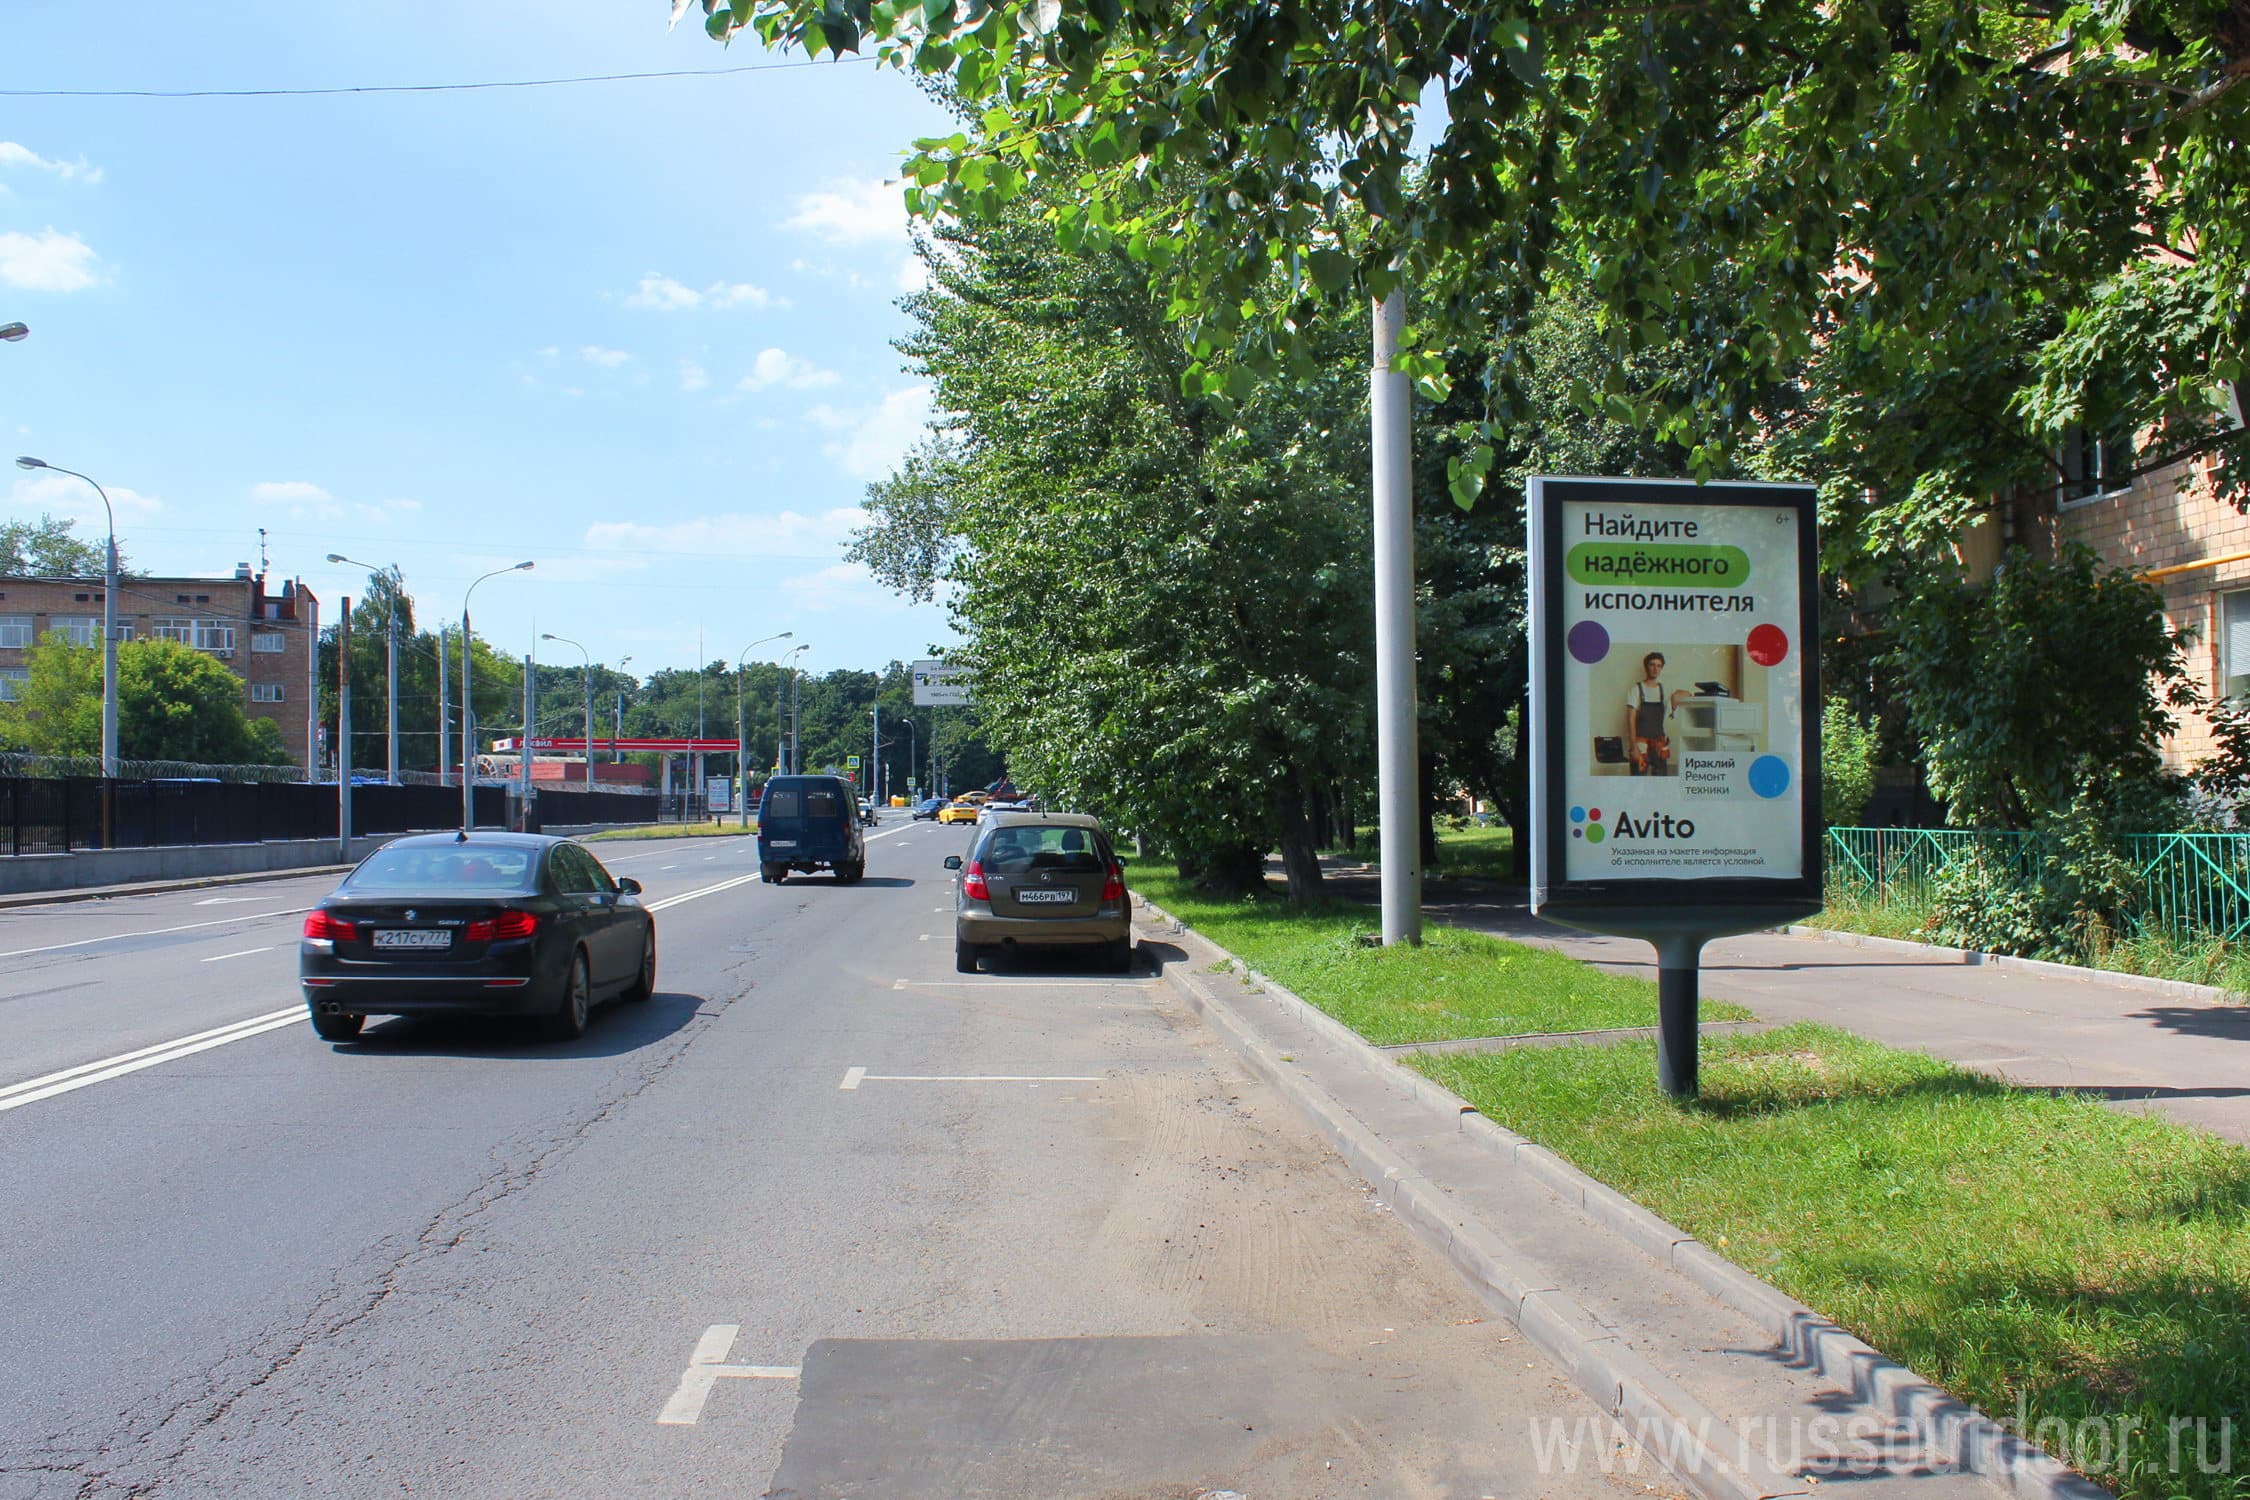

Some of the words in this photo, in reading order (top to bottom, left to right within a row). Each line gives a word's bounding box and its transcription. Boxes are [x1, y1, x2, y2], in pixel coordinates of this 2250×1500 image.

[1775, 513, 1790, 525] 6+
[1585, 512, 1698, 541] Найдите
[1585, 551, 1729, 578] надёжного
[1585, 592, 1754, 613] исполнителя
[1685, 757, 1735, 770] Ираклий
[1685, 770, 1726, 782] Ремонт
[1685, 785, 1730, 795] техники
[1613, 811, 1695, 839] Avito
[1611, 847, 1655, 857] Указанная
[1702, 847, 1757, 858] информация
[1611, 857, 1623, 866] об
[1624, 858, 1681, 867] исполнителе
[1683, 858, 1721, 867] является
